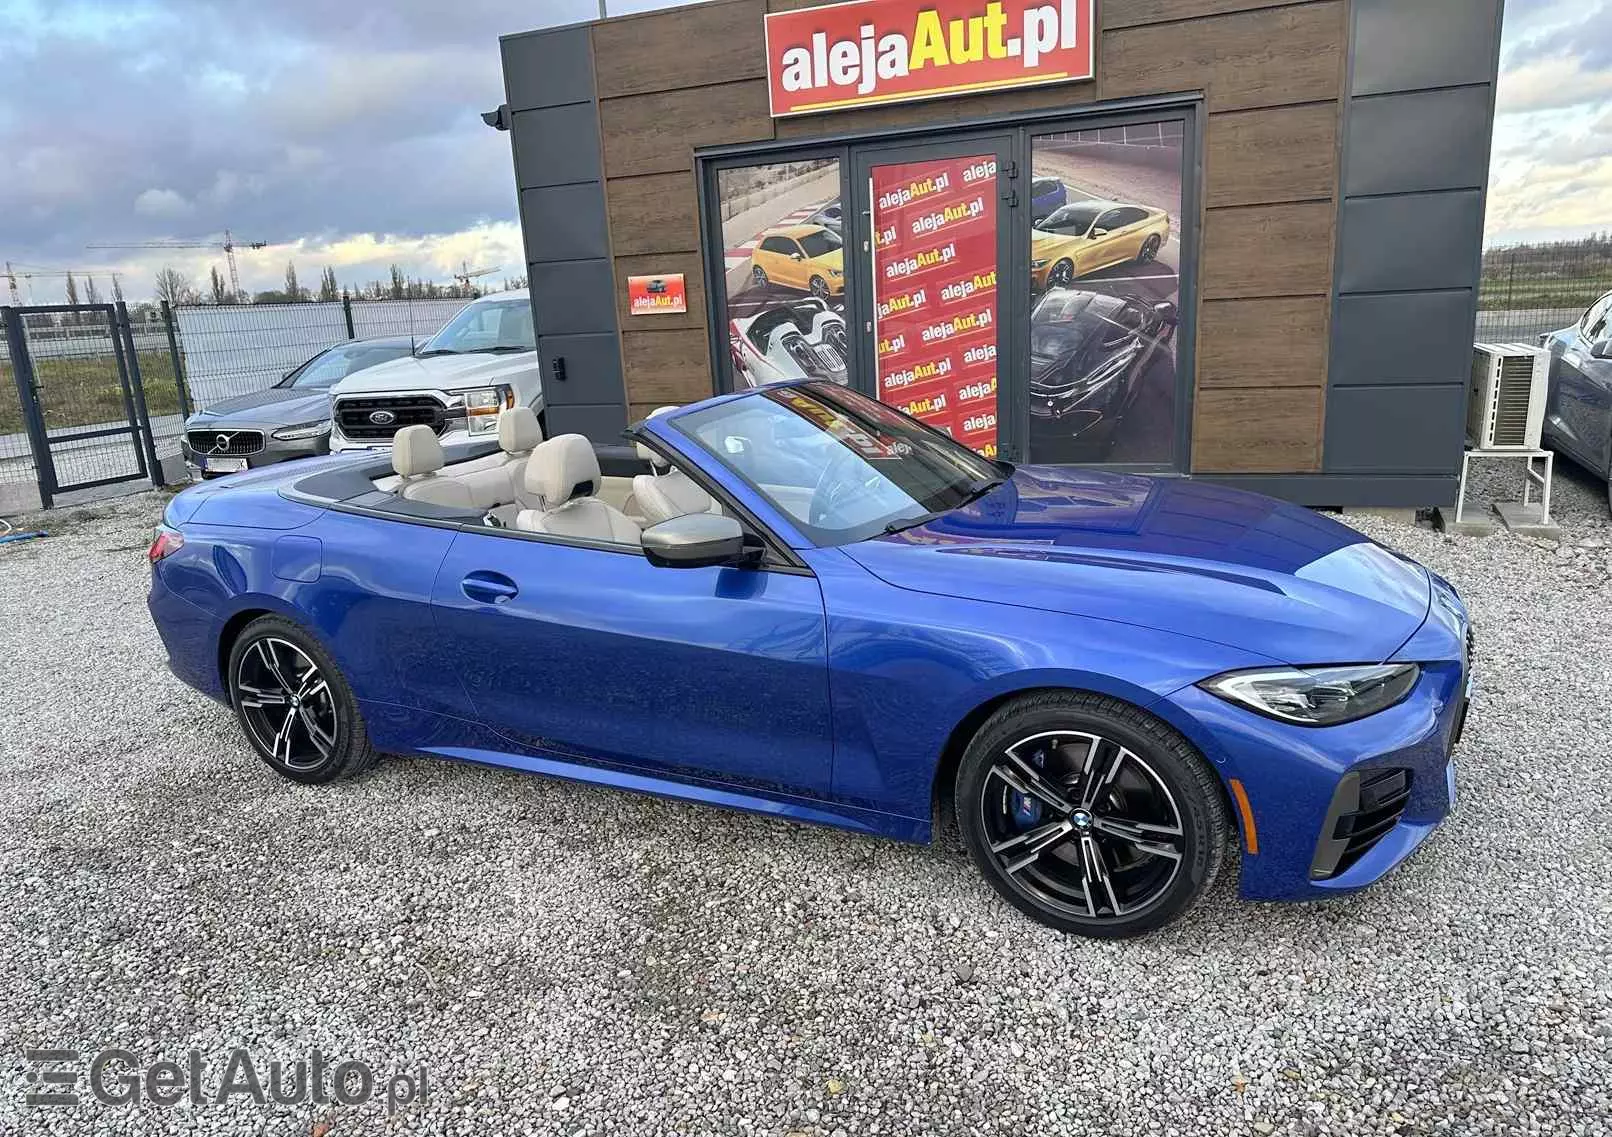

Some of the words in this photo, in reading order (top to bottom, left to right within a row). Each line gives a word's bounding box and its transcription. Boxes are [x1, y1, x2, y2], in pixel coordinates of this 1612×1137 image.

[781, 0, 1077, 94] alejaAut.pl
[879, 173, 949, 209] alejaAut.pl
[912, 197, 984, 233] alejaAut.pl
[886, 243, 956, 278] alejaAut.pl
[633, 293, 683, 308] alejaAut.pl
[921, 309, 992, 341] alejaAut.pl
[884, 358, 952, 388] alejaAut.pl
